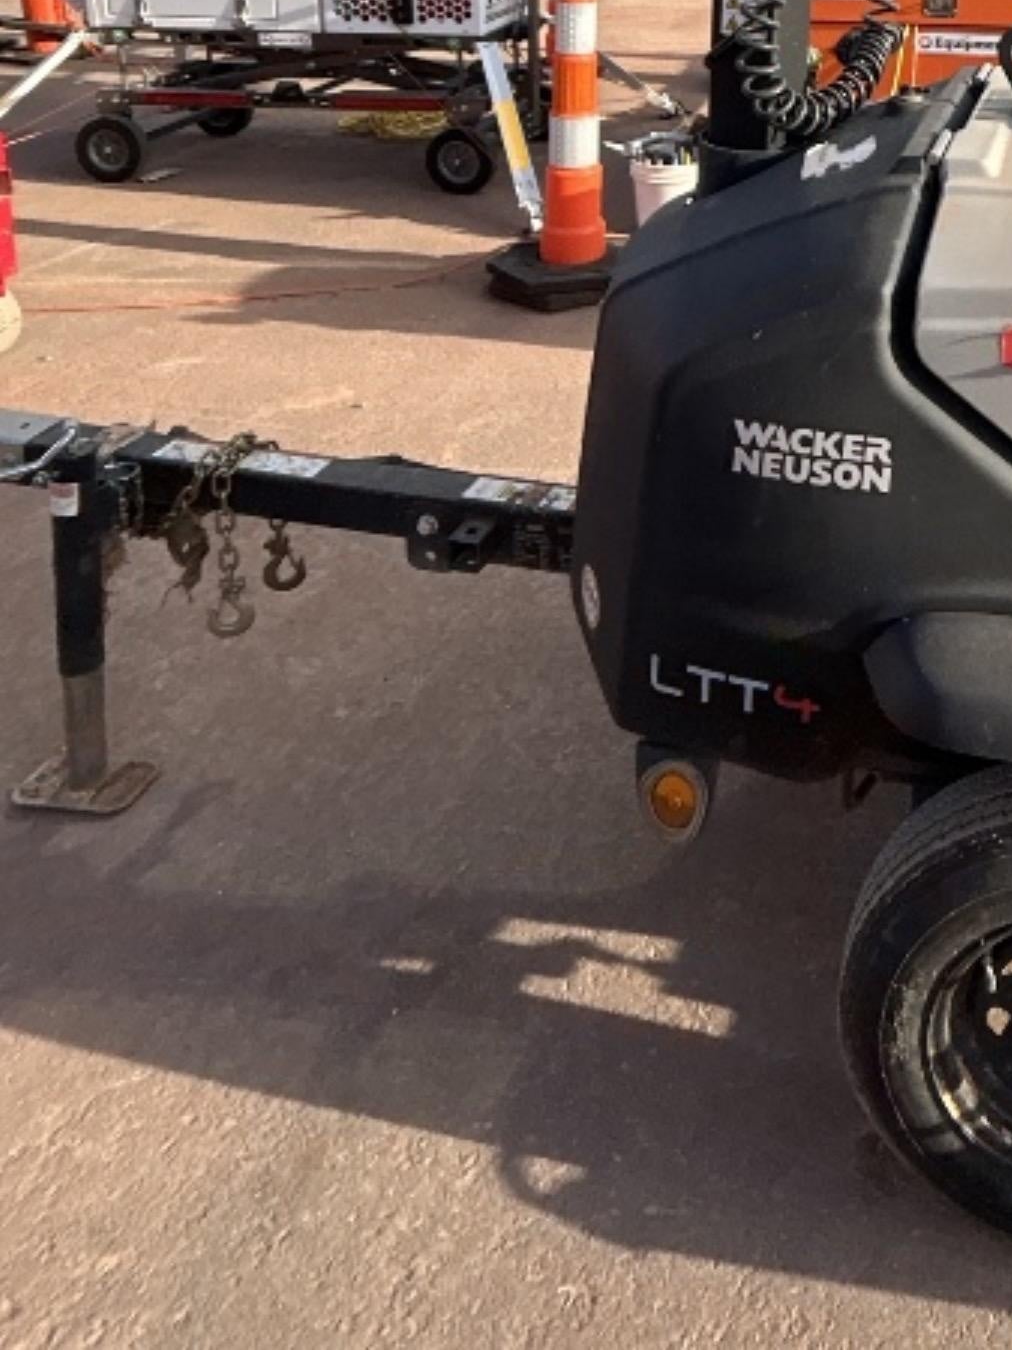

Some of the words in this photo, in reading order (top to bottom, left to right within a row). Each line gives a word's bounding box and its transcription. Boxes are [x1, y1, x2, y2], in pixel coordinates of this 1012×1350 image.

[734, 418, 892, 466] WACKER
[731, 446, 892, 494] NEUSON
[650, 653, 820, 723] LTT4
